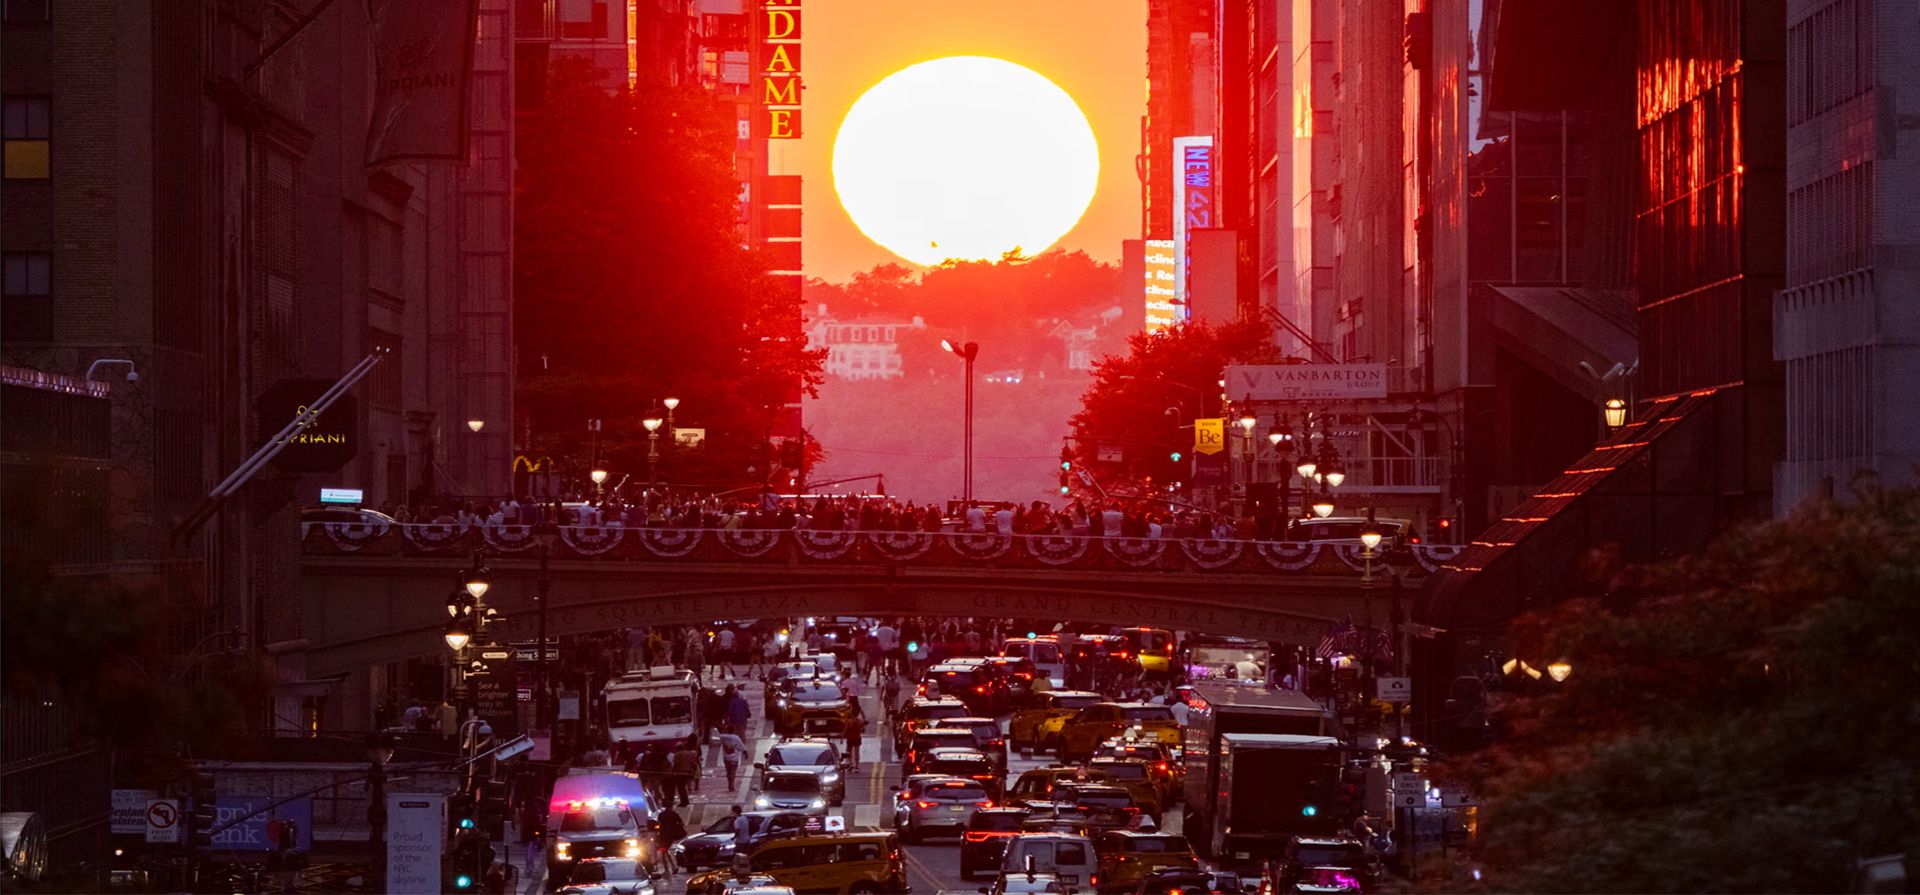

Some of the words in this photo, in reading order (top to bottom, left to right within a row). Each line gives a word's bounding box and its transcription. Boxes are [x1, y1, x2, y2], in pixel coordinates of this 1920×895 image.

[762, 0, 799, 138] DAME
[1187, 148, 1209, 187] NEW
[1275, 370, 1380, 381] VANBARTON
[276, 433, 346, 444] PRIANI
[1198, 429, 1220, 445] Be
[595, 600, 704, 621] SQUARE
[724, 594, 810, 611] PLAZA
[973, 596, 1071, 612] GRAND
[1091, 602, 1219, 625] CENTRAL
[1239, 614, 1311, 637] TERM
[215, 803, 268, 823] pple
[211, 826, 261, 844] ank
[393, 832, 423, 842] Proud
[393, 845, 433, 854] sponsor
[393, 854, 403, 863] of
[404, 854, 422, 863] the
